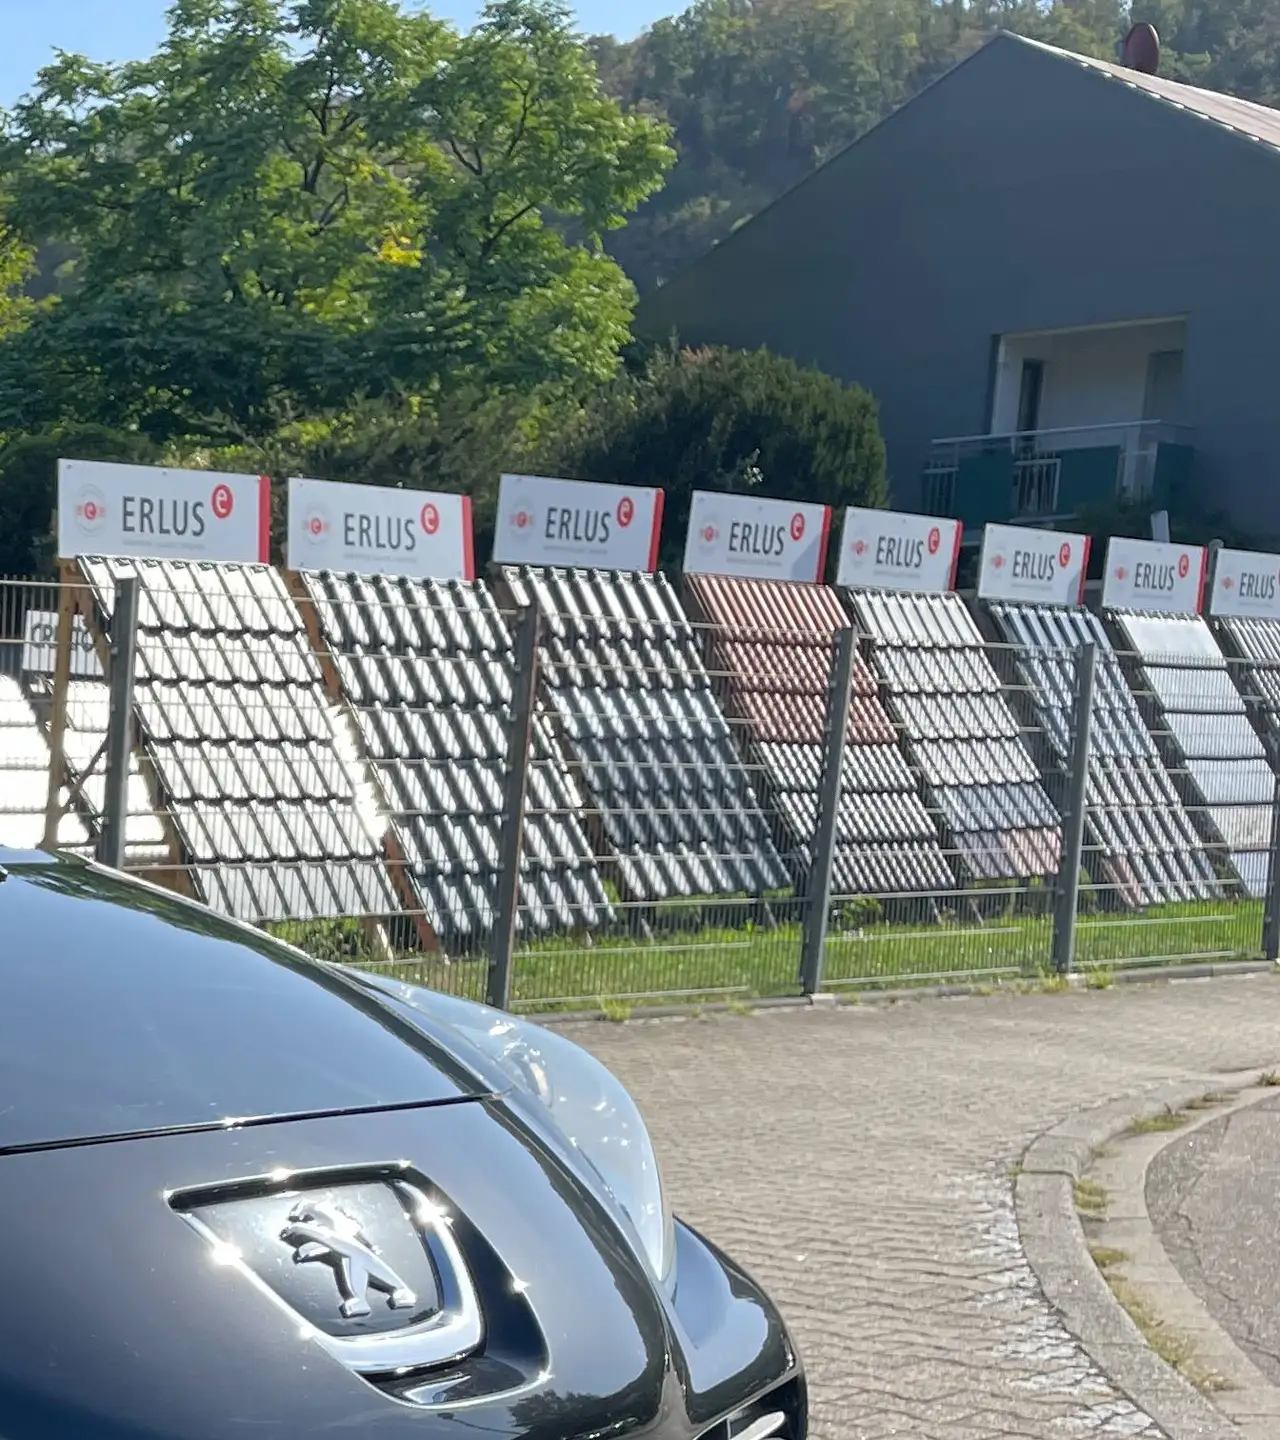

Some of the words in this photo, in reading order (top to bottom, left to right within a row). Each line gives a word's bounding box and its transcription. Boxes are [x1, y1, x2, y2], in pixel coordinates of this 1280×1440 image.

[122, 496, 205, 537] ERLUS
[343, 512, 416, 551] ERLUS
[545, 506, 612, 543] ERLUS
[729, 522, 786, 556] ERLUS
[875, 535, 924, 568] ERLUS
[1012, 551, 1056, 581] ERLUS
[1135, 562, 1176, 591] ERLUS
[1239, 572, 1275, 600] ERLUS
